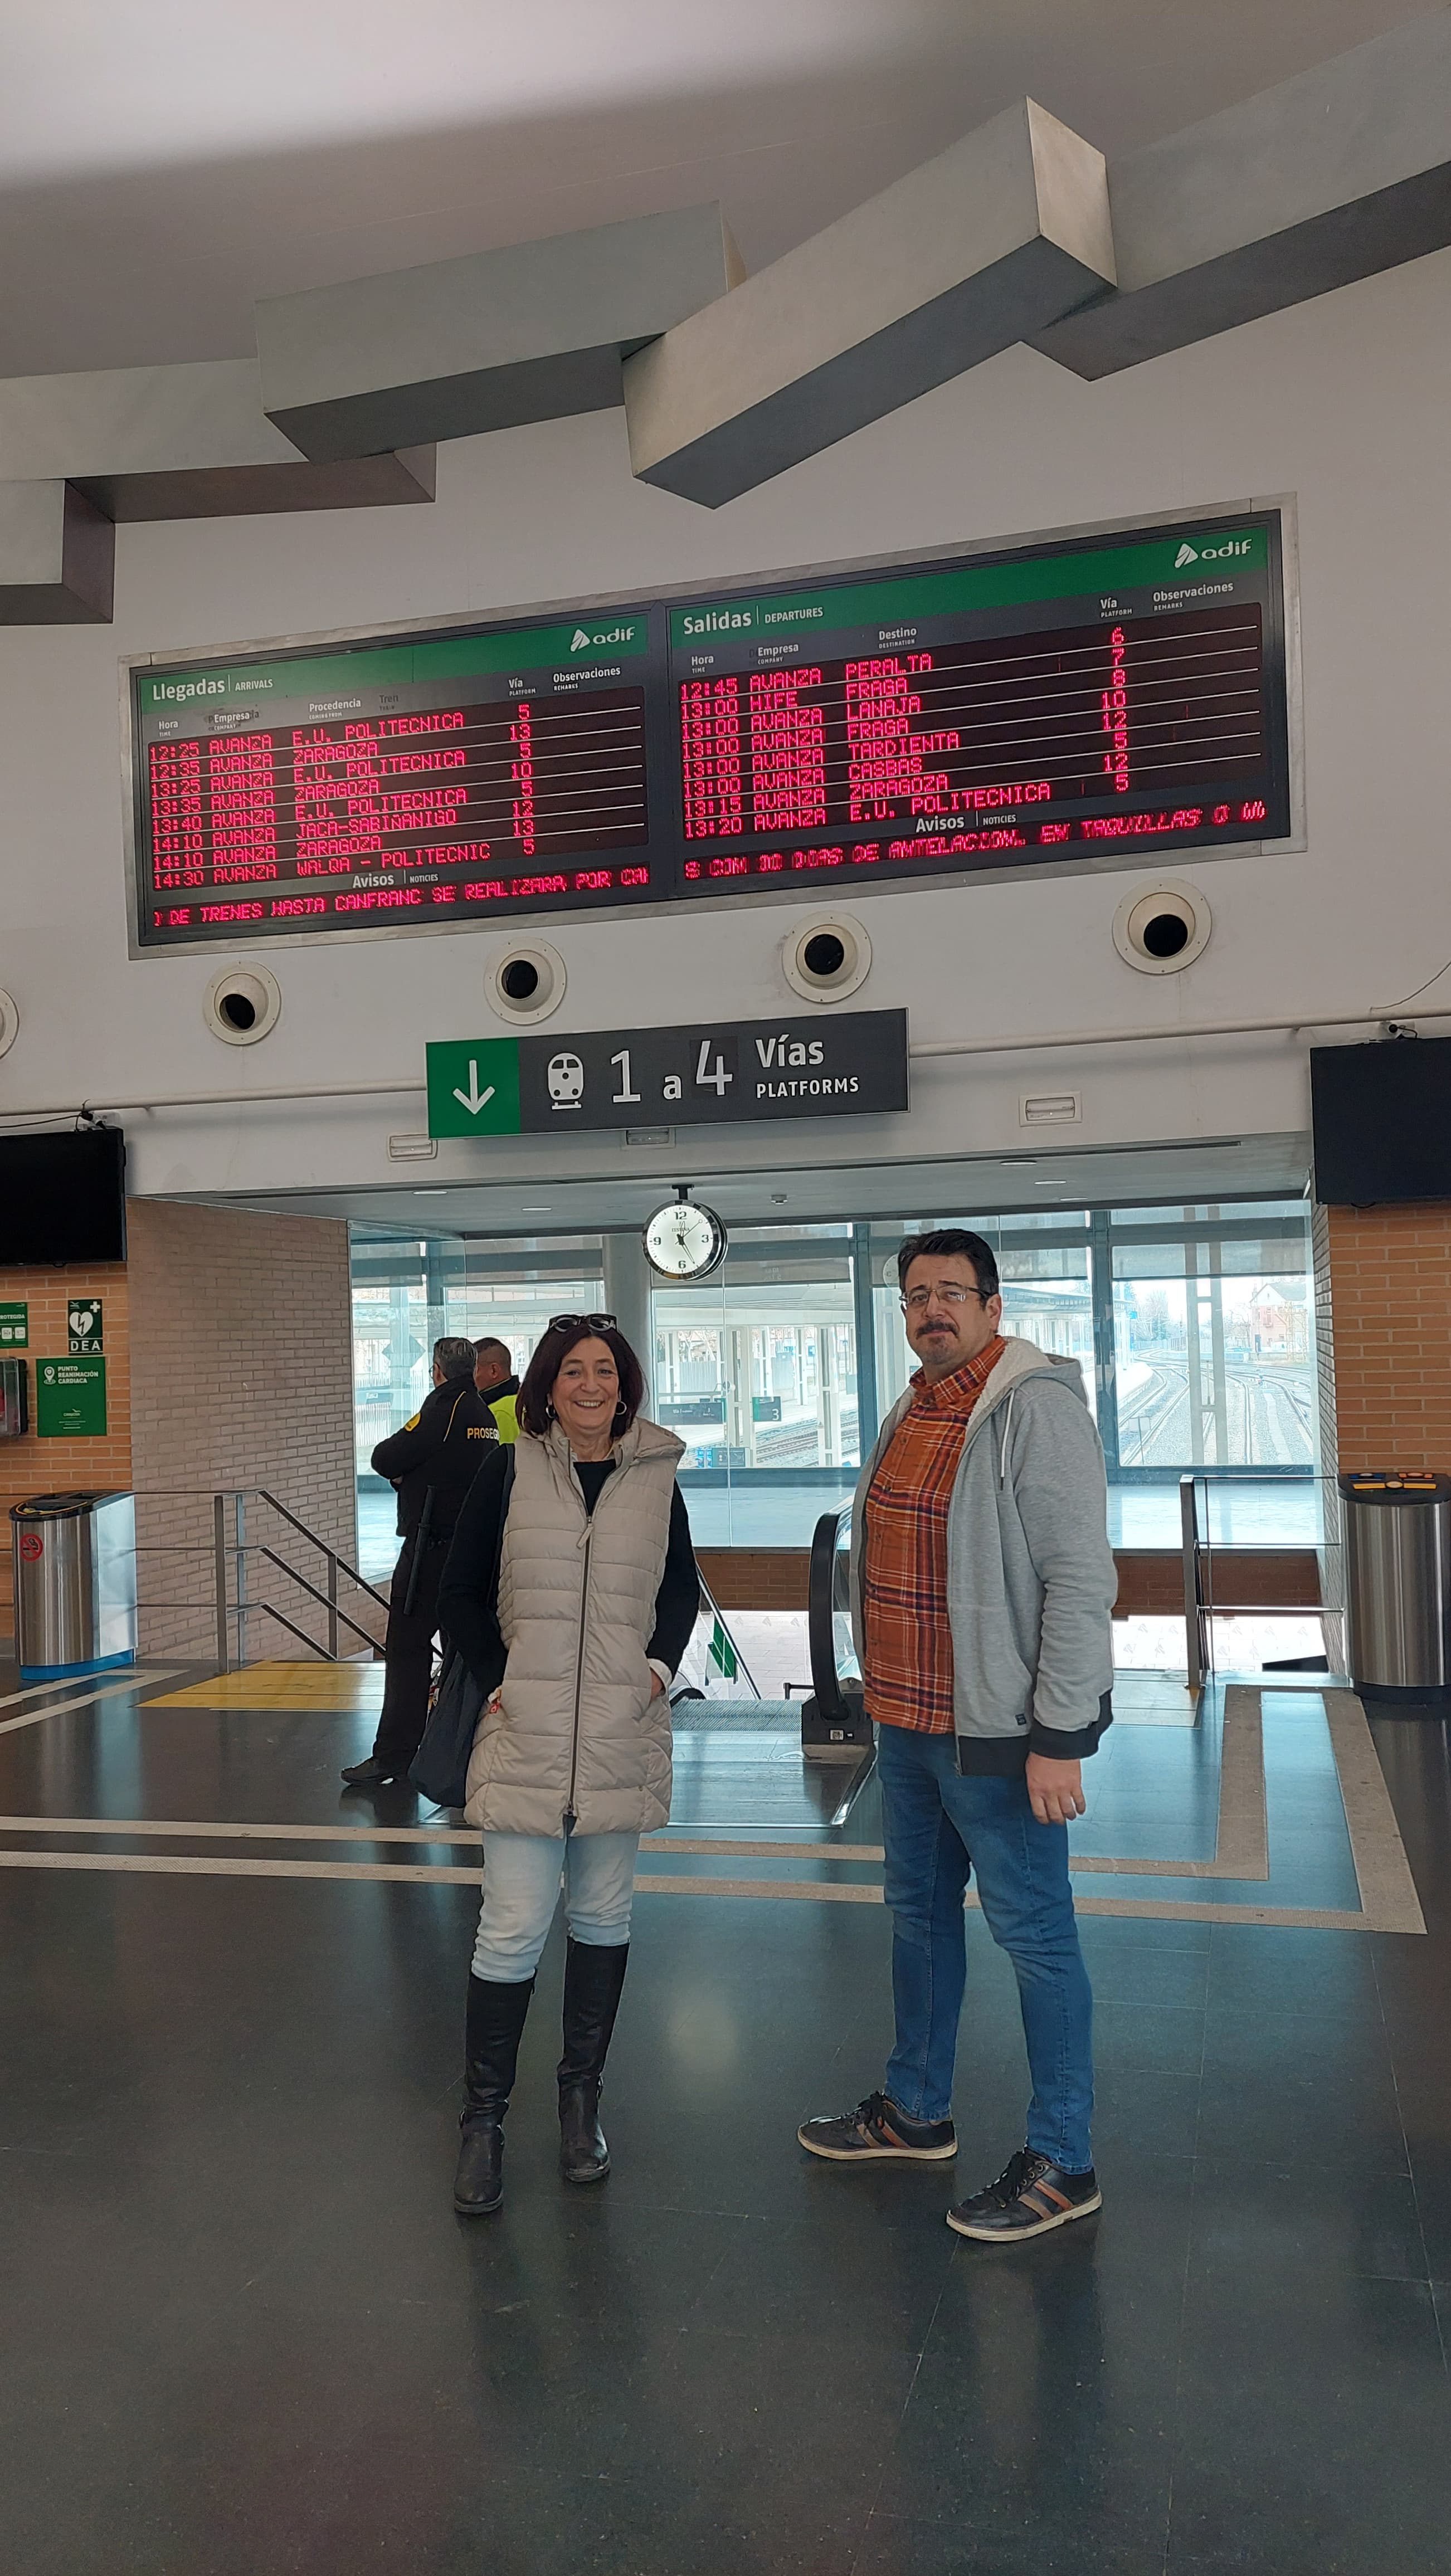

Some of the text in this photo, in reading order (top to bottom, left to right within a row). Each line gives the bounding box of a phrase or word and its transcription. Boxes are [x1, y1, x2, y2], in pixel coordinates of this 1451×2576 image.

[1201, 539, 1252, 559] adif
[592, 626, 635, 644] adif
[684, 607, 824, 635] Salidas DEPARTURES
[692, 581, 1234, 666] Hora Empresa Destino Vía Observaciones
[758, 656, 783, 665] COMPANY
[879, 638, 916, 648] DESTINATION
[1101, 608, 1133, 618] PLATFORM
[1154, 602, 1183, 611] REMARKS
[153, 679, 273, 701] Llegadas ARRIVALS
[681, 626, 1124, 702] 12:45 AVANZA PERALTA 6
[681, 647, 1124, 721] 13:00 HIFE FRAGA 7
[159, 720, 178, 730] Hora
[215, 712, 250, 723] Empresa
[309, 699, 362, 712] Procedencia
[509, 677, 523, 689] Vía
[553, 667, 621, 682] Observaciones
[509, 687, 536, 696] PLATFORM
[682, 667, 1126, 741] 13:00 AVANZA LANAJA 8
[149, 703, 530, 762] 12:25 AVANZA E.U. POLITECNICA 5
[150, 723, 531, 780] 12:35 AVANZA ZARAGOZA 13
[683, 689, 1126, 761] 13:00 AVANZA FRAGA 10
[683, 709, 1127, 780] 13:00 AVANZA TARDIENTA 12
[150, 741, 531, 798] 13:25 AVANZA E.U. POLITECNICA 5
[151, 761, 533, 817] 13:35 AVANZA ZARAGOZA 10
[684, 730, 1127, 800] 13:00 AVANZA CASBAS 5
[684, 751, 1128, 819] 13:15 AVANZA ZARAGOZA 12
[152, 780, 533, 835] 13:40 AVANZA E.U. POLITECNICA 5
[153, 833, 203, 853] 14:10
[211, 826, 276, 847] AVANZA
[512, 799, 533, 817] 12
[685, 772, 1128, 840] 13:20 AVANZA E.U. POLITECNICA 5
[916, 814, 1016, 833] Avisos NOTICIES
[153, 818, 534, 871] 14:10 AVANZA ZARAGOZA 13
[154, 869, 204, 889] 14:30
[213, 862, 277, 884] AVANZA
[296, 855, 351, 876] WALQA
[380, 842, 490, 868] POLITECNIC
[523, 838, 534, 855] 5
[169, 908, 191, 925] DE
[199, 902, 263, 922] TRENES
[270, 896, 327, 916] HASTA
[334, 888, 422, 911] CANFRANC
[431, 885, 456, 902] SE
[574, 871, 612, 890] POR
[352, 873, 439, 889] Avisos NOTICIES
[610, 1034, 825, 1104] 1 a 4 Vías
[757, 1075, 859, 1098] PLATFORMS
[653, 1237, 661, 1246] 9
[674, 1211, 686, 1220] 12
[702, 1235, 709, 1243] 3
[678, 1260, 686, 1269] 6
[70, 1340, 101, 1351] DEA
[772, 1408, 779, 1421] 3
